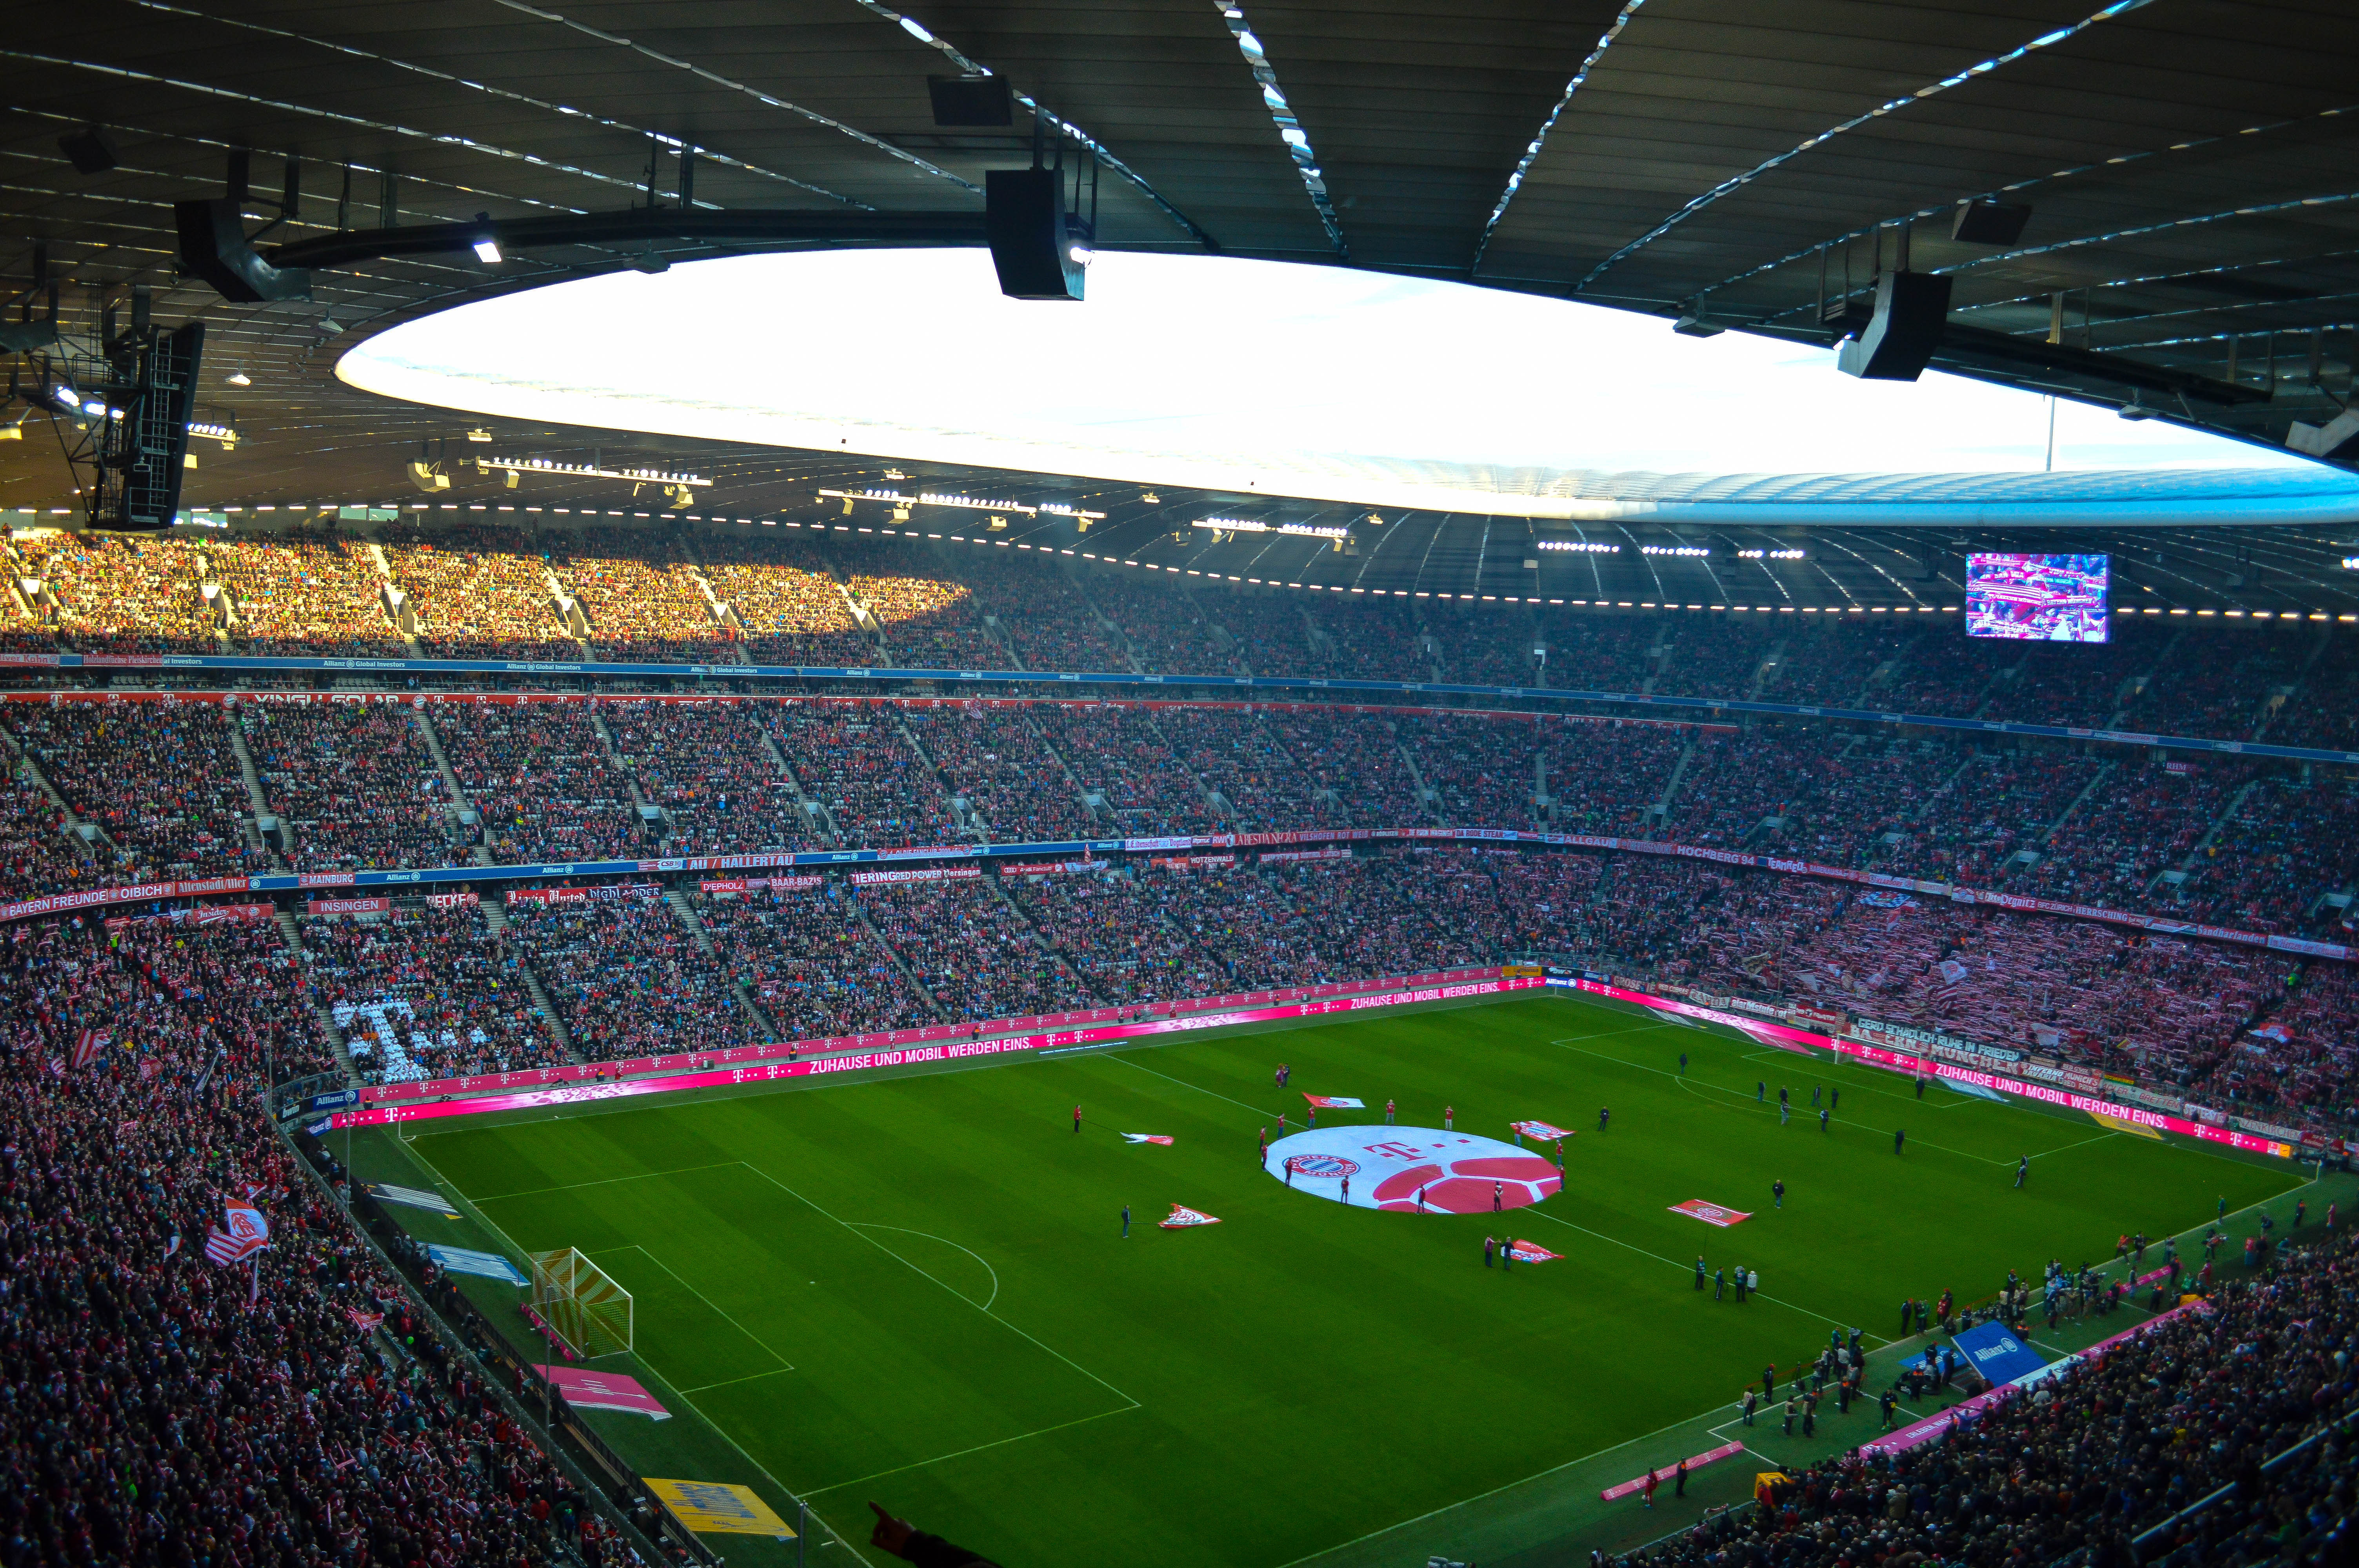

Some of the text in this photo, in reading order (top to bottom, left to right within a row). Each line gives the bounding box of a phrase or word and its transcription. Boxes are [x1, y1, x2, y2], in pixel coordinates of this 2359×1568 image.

[689, 859, 708, 869] AU
[721, 855, 795, 868] HALLERTAU
[309, 874, 353, 884] MAINBURG
[896, 870, 942, 880] RED POWER
[120, 885, 162, 899] OIBICH
[9, 891, 106, 916] BAYERN FREUNDE
[320, 900, 379, 912] INSINGEN
[197, 908, 229, 919] Insider
[2075, 906, 2128, 922] HERRSCHING
[2198, 925, 2265, 944] Sandharlanden
[1350, 982, 1500, 1009] ZUHAUSE UND MOBIL WERDEN EINS.
[809, 1036, 1033, 1074] ZUHAUSE UND MOBIL WERDEN EINS.
[1965, 1041, 1976, 1053] IN
[1977, 1044, 2020, 1062] FRIEDEN
[316, 1093, 344, 1105] Allianz
[1935, 1063, 1993, 1085] ZUHAUSE
[1996, 1076, 2023, 1094] UND
[2026, 1083, 2067, 1105] MOBIL
[2071, 1094, 2129, 1120] WERDEN
[2133, 1109, 2168, 1129] EINS.
[282, 1104, 300, 1118] bwin
[1977, 1343, 2004, 1362] Allianz
